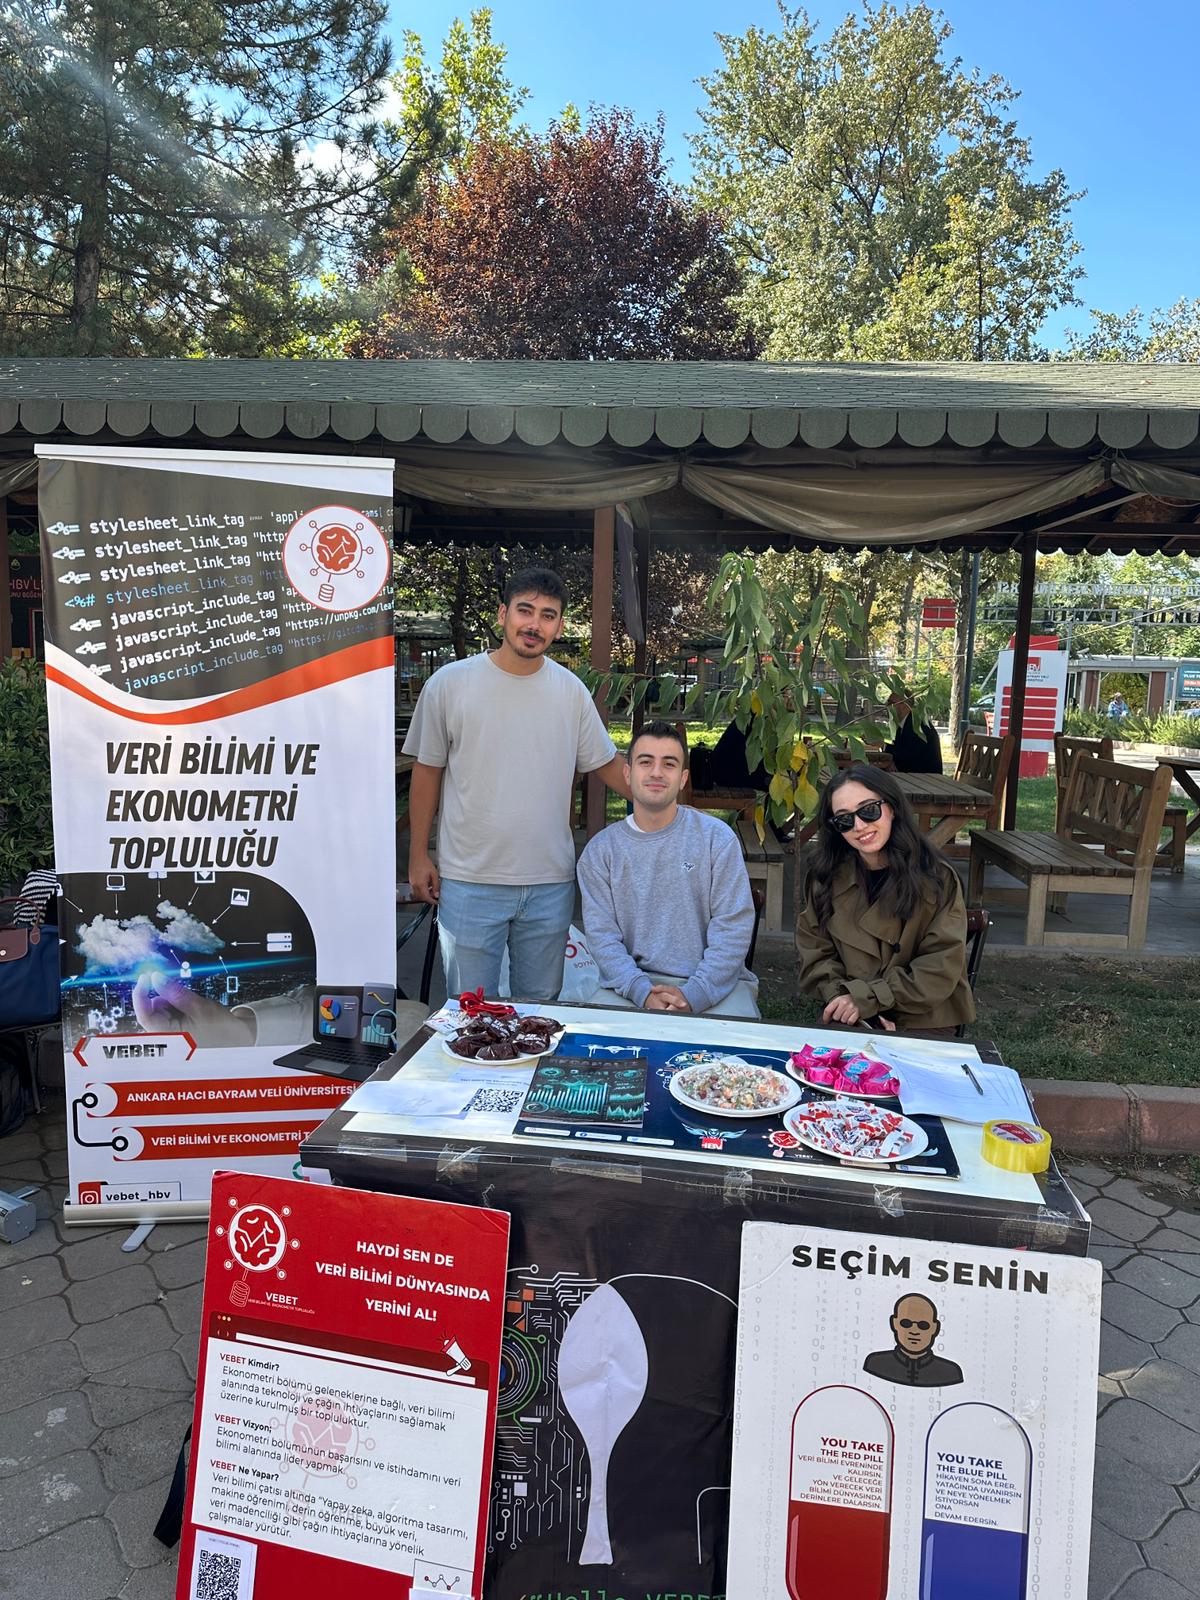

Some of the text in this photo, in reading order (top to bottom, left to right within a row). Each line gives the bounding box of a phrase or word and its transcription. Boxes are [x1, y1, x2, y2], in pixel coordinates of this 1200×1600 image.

[89, 514, 245, 537] stylesheet_link_tag
[95, 534, 248, 558] stylesheet_link_tag
[100, 553, 251, 582] stylesheet_link_tag
[106, 573, 254, 605] stylesheet_link_tag
[110, 588, 275, 629] javascript_include_tag
[114, 607, 278, 652] javascript_include_tag
[119, 624, 281, 674] javascript_include_tag
[124, 643, 284, 694] javascript_include_tag
[105, 735, 320, 776] VERİ BİLİMİ VE
[105, 783, 299, 822] EKONOMETRİ
[108, 828, 279, 869] TOPLULUĞU
[102, 1043, 168, 1059] VEBET
[126, 1083, 356, 1103] ANKARA HACI BAYRAM VELİ ÜNİVERSİTESİ
[151, 1132, 176, 1147] VERİ
[178, 1132, 211, 1146] BİLİMİ
[213, 1133, 228, 1145] VE
[229, 1129, 302, 1143] EKONOMETRİ
[105, 1189, 171, 1201] vebet_hbv
[356, 1240, 454, 1267] HAYDİ SEN DE
[315, 1261, 490, 1302] VERİ BİLİMİ DÜNYASINDA
[791, 1244, 1049, 1294] SEÇİM SENİN
[265, 1292, 299, 1305] VEBET
[366, 1298, 437, 1322] YERİNİ AL!
[219, 1353, 280, 1371] VEBET Kimdir?
[221, 1379, 446, 1432] alanında teknoloji ve çağın ihtiyaçlarını sağlamak
[222, 1366, 275, 1384] Ekonometri
[314, 1385, 378, 1404] geleneklerine
[408, 1403, 425, 1414] veri
[428, 1406, 455, 1420] bilimi
[214, 1413, 272, 1433] VEBET Vizyon;
[220, 1390, 369, 1429] üzerine kurulmuş bir topluluktur.
[216, 1438, 241, 1452] bilimi
[243, 1445, 282, 1460] alanında
[284, 1453, 304, 1465] lider
[217, 1426, 270, 1445] Ekonometri
[374, 1462, 385, 1470] ve
[387, 1462, 441, 1482] istihdamını
[443, 1477, 461, 1487] veri
[821, 1437, 884, 1453] YOU TAKE
[821, 1449, 884, 1463] THE RED PILL
[210, 1460, 279, 1481] VEBET Ne Yapar?
[937, 1452, 1003, 1469] YOU TAKE
[937, 1464, 1008, 1480] THE BLUE PILL
[971, 1478, 993, 1486] SONA
[211, 1486, 245, 1500] makine
[292, 1504, 316, 1517] derin
[365, 1521, 395, 1536] büyük
[398, 1530, 417, 1542] veri,
[212, 1472, 230, 1484] Veri
[231, 1477, 257, 1491] bilimi
[284, 1489, 316, 1504] altında
[351, 1505, 375, 1518] zeka,
[377, 1511, 424, 1529] algoritma
[209, 1511, 253, 1528] çalışmalar
[210, 1499, 425, 1556] veri madenciliği gibi çağın ihtiyaçlarına yönelik
